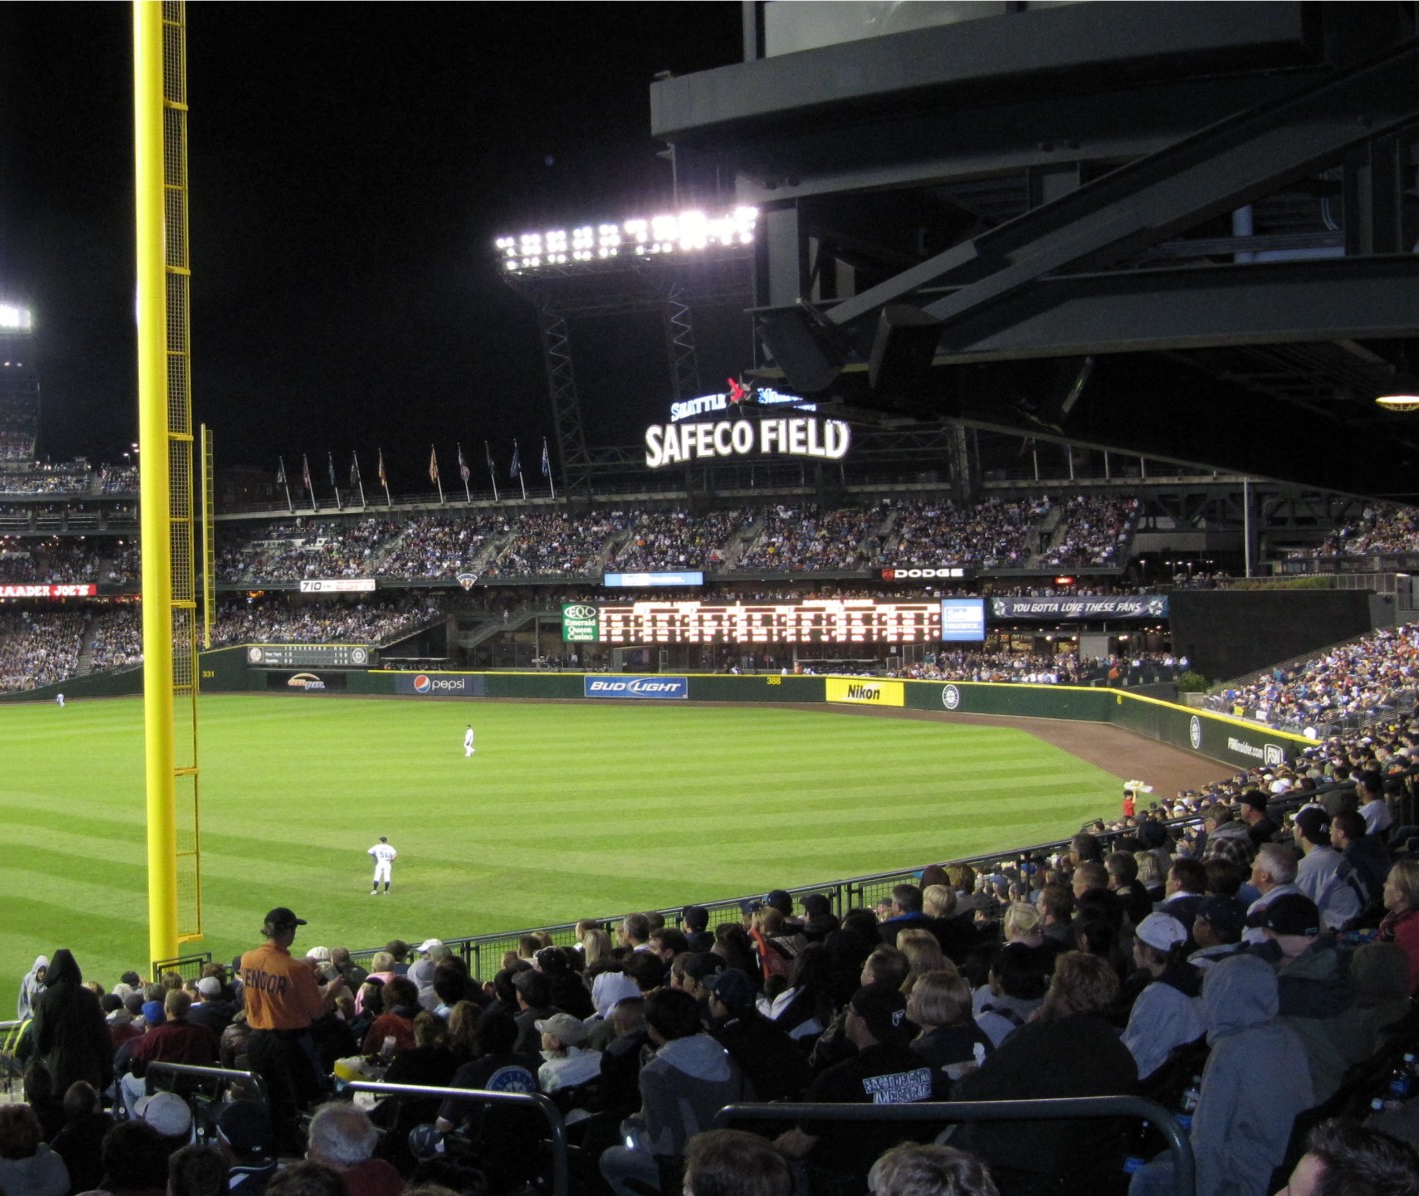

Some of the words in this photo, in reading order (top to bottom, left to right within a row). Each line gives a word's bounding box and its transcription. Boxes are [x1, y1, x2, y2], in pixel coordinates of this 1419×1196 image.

[670, 393, 727, 422] SEATTLE
[645, 420, 754, 468] SAFECO
[760, 417, 850, 459] FIELD
[894, 568, 964, 578] DODGE
[53, 585, 90, 596] JOE'S
[303, 581, 322, 591] 710
[1013, 602, 1030, 612] YOU
[1031, 602, 1059, 613] GOTTA
[1061, 602, 1084, 612] LOVE
[1085, 602, 1115, 612] THESE
[1116, 602, 1142, 612] FANS
[565, 618, 596, 627] Emerald
[568, 626, 593, 634] Queen
[202, 670, 215, 678] 331
[431, 677, 465, 691] pepsi
[590, 681, 626, 691] BUD
[632, 682, 681, 692] LIGHT
[766, 677, 781, 685] 388
[847, 684, 880, 700] Nikon
